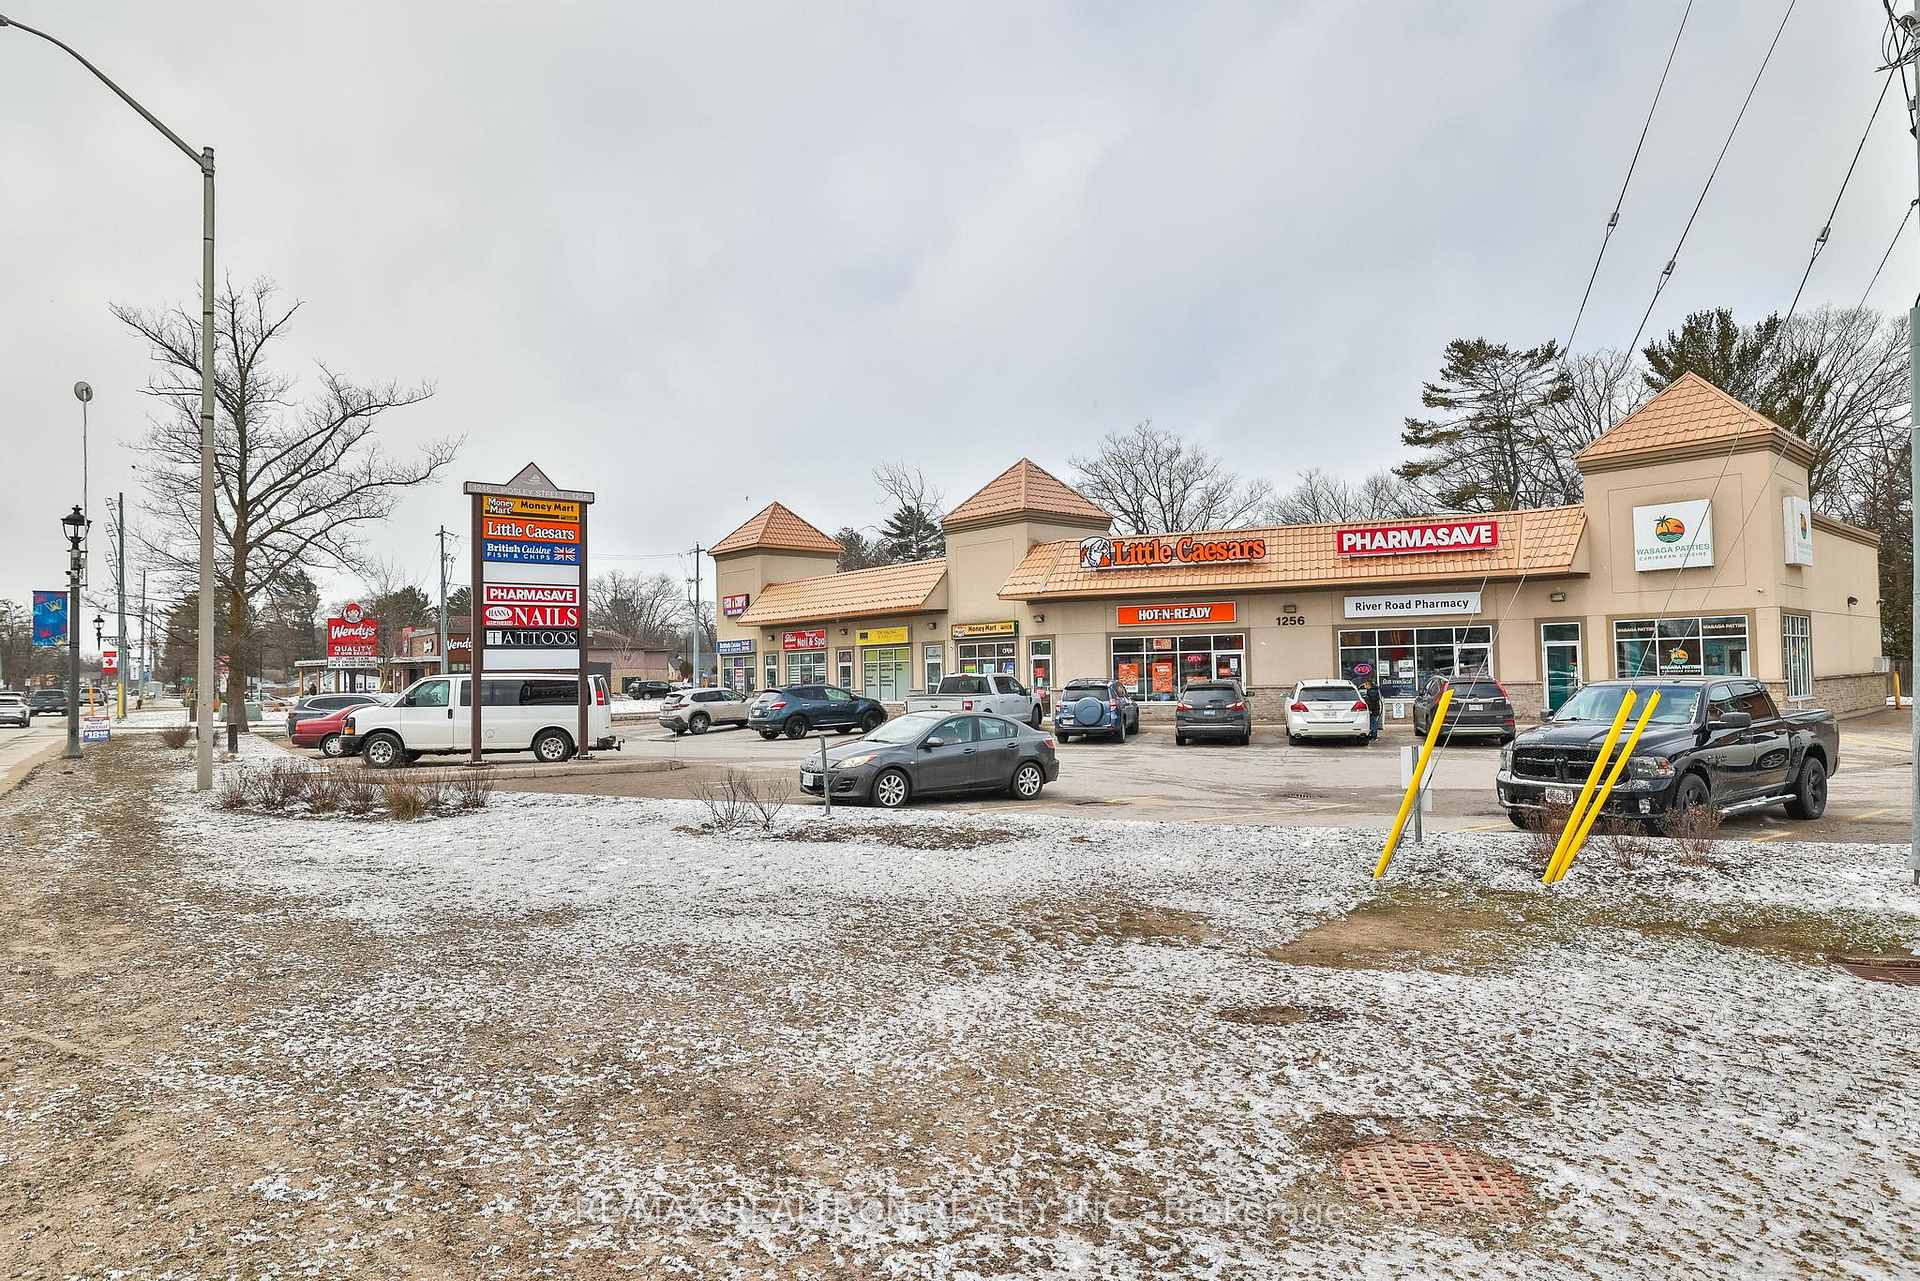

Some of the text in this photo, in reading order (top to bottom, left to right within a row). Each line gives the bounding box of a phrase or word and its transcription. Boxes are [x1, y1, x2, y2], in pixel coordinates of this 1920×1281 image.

[488, 496, 514, 507] Money
[521, 500, 575, 512] Money Mart
[489, 505, 512, 515] Mart
[487, 521, 575, 540] Little Caesars
[1342, 525, 1493, 551] PHARMASAVE
[487, 543, 552, 555] British Cuisine
[1112, 537, 1266, 565] Little Caesars
[1636, 543, 1710, 556] WASAGA PATTIES
[490, 588, 574, 601] PHARMASAVE
[1355, 598, 1469, 612] River Road Pharmacy
[513, 607, 578, 626] NAILS
[1138, 607, 1212, 621] HOT-N-READY
[1276, 616, 1305, 626] 1256
[332, 623, 376, 640] Wendy's
[488, 631, 576, 645] TATTOOS
